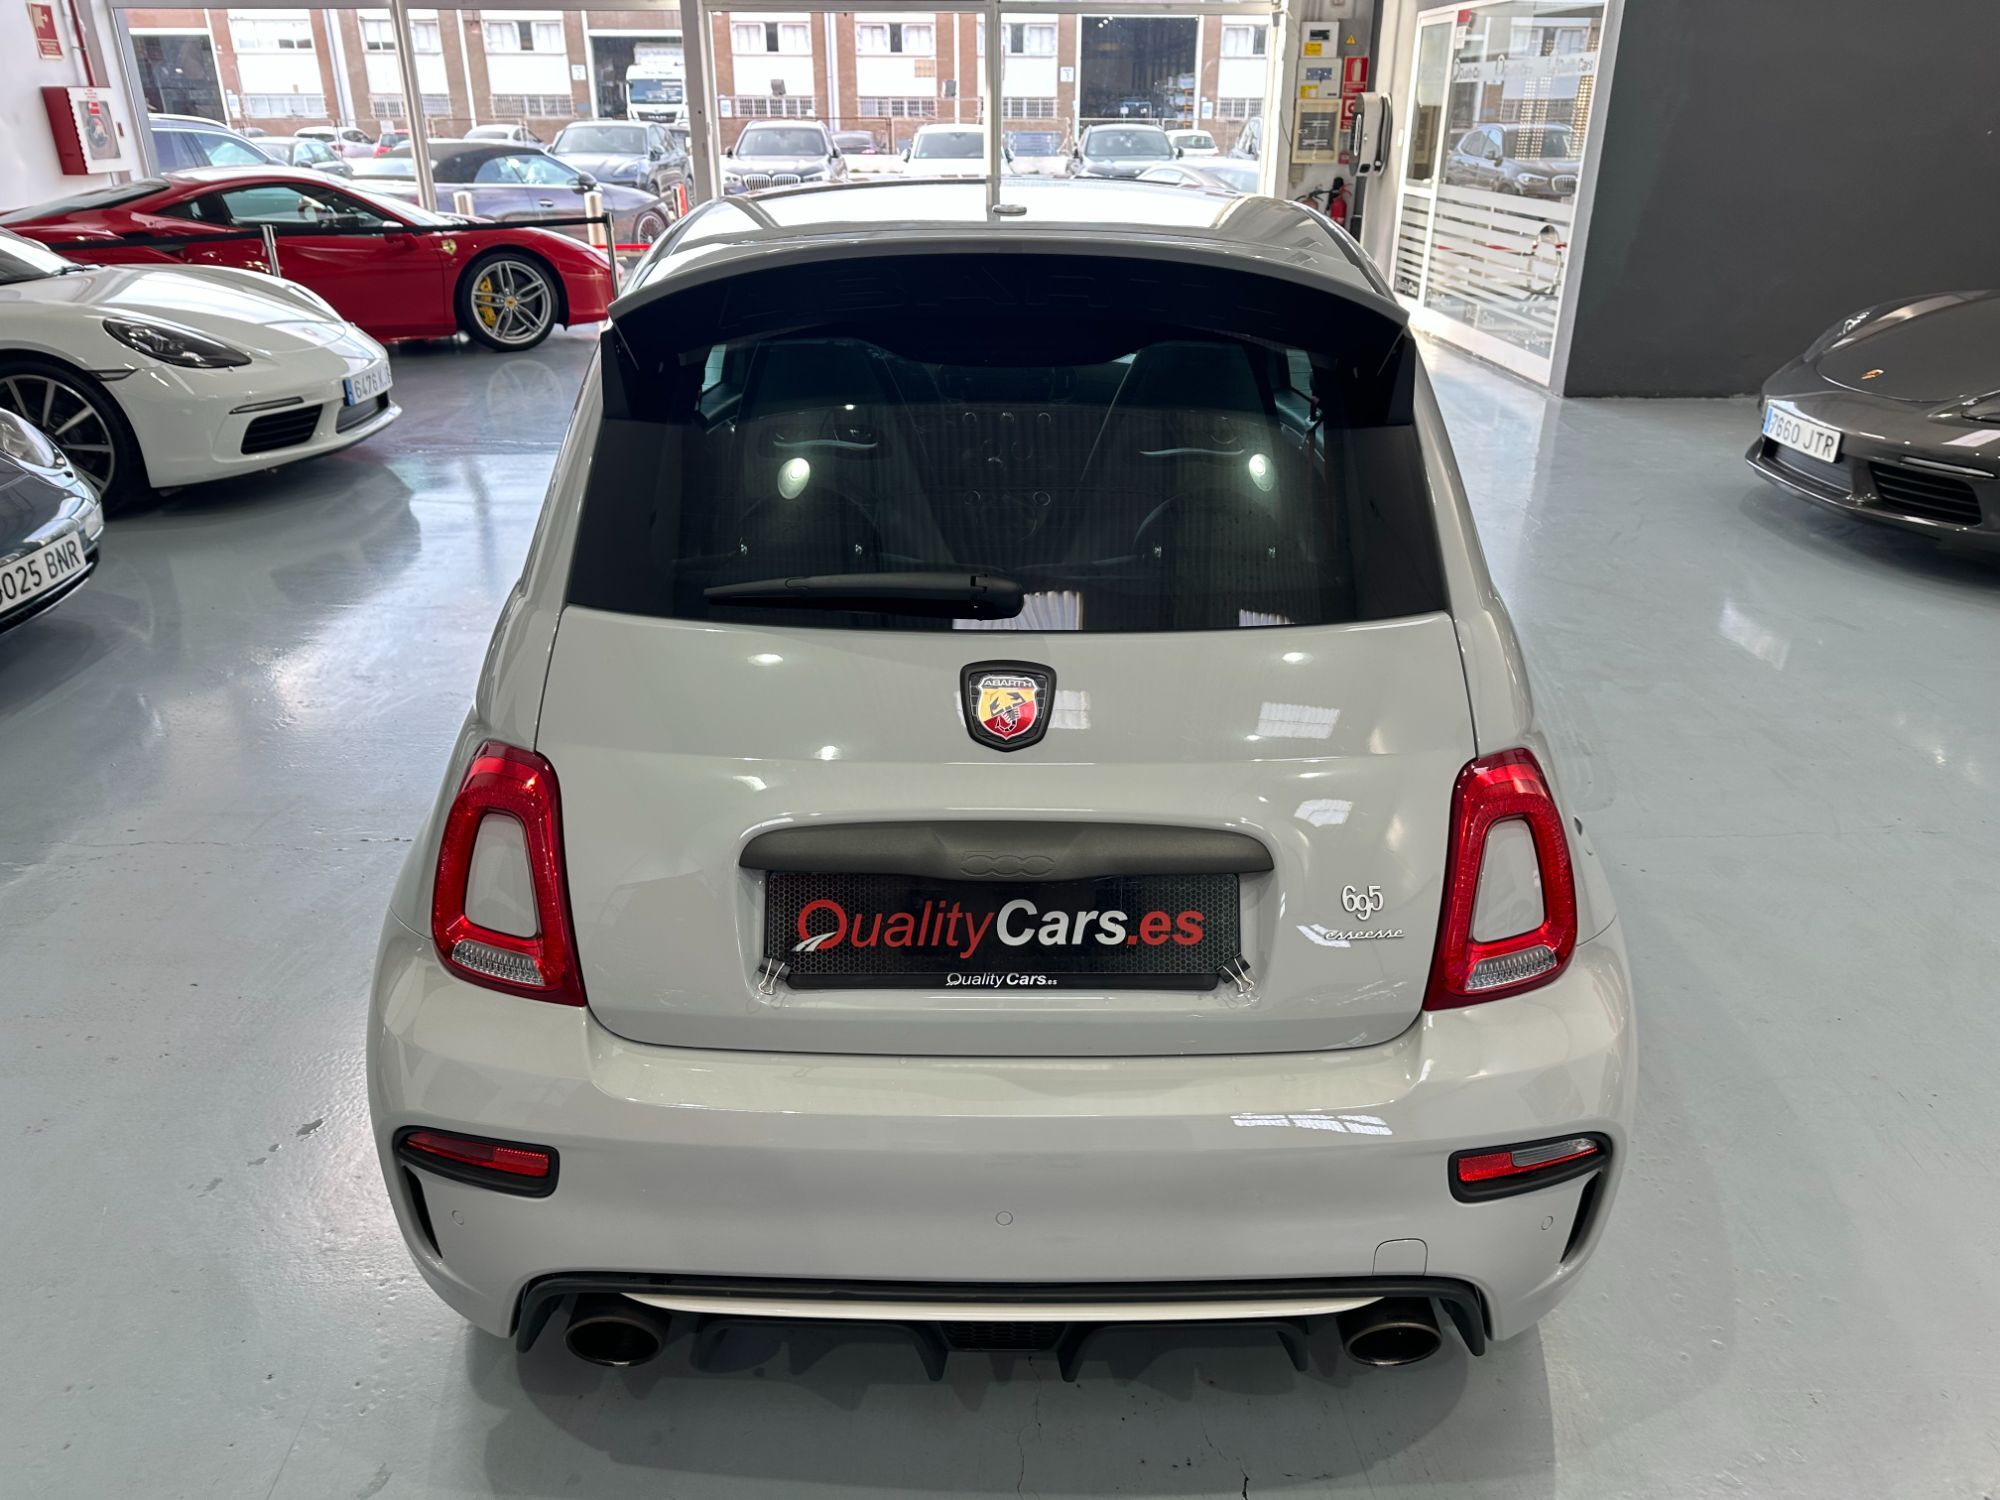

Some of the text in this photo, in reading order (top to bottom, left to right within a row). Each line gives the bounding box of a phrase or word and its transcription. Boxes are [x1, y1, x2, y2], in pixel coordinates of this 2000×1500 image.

[353, 372, 378, 399] 6476
[1769, 413, 1835, 458] 7660 JTR
[44, 540, 81, 579] BNR
[1341, 885, 1384, 921] 695
[792, 899, 1206, 959] QualityCars.es
